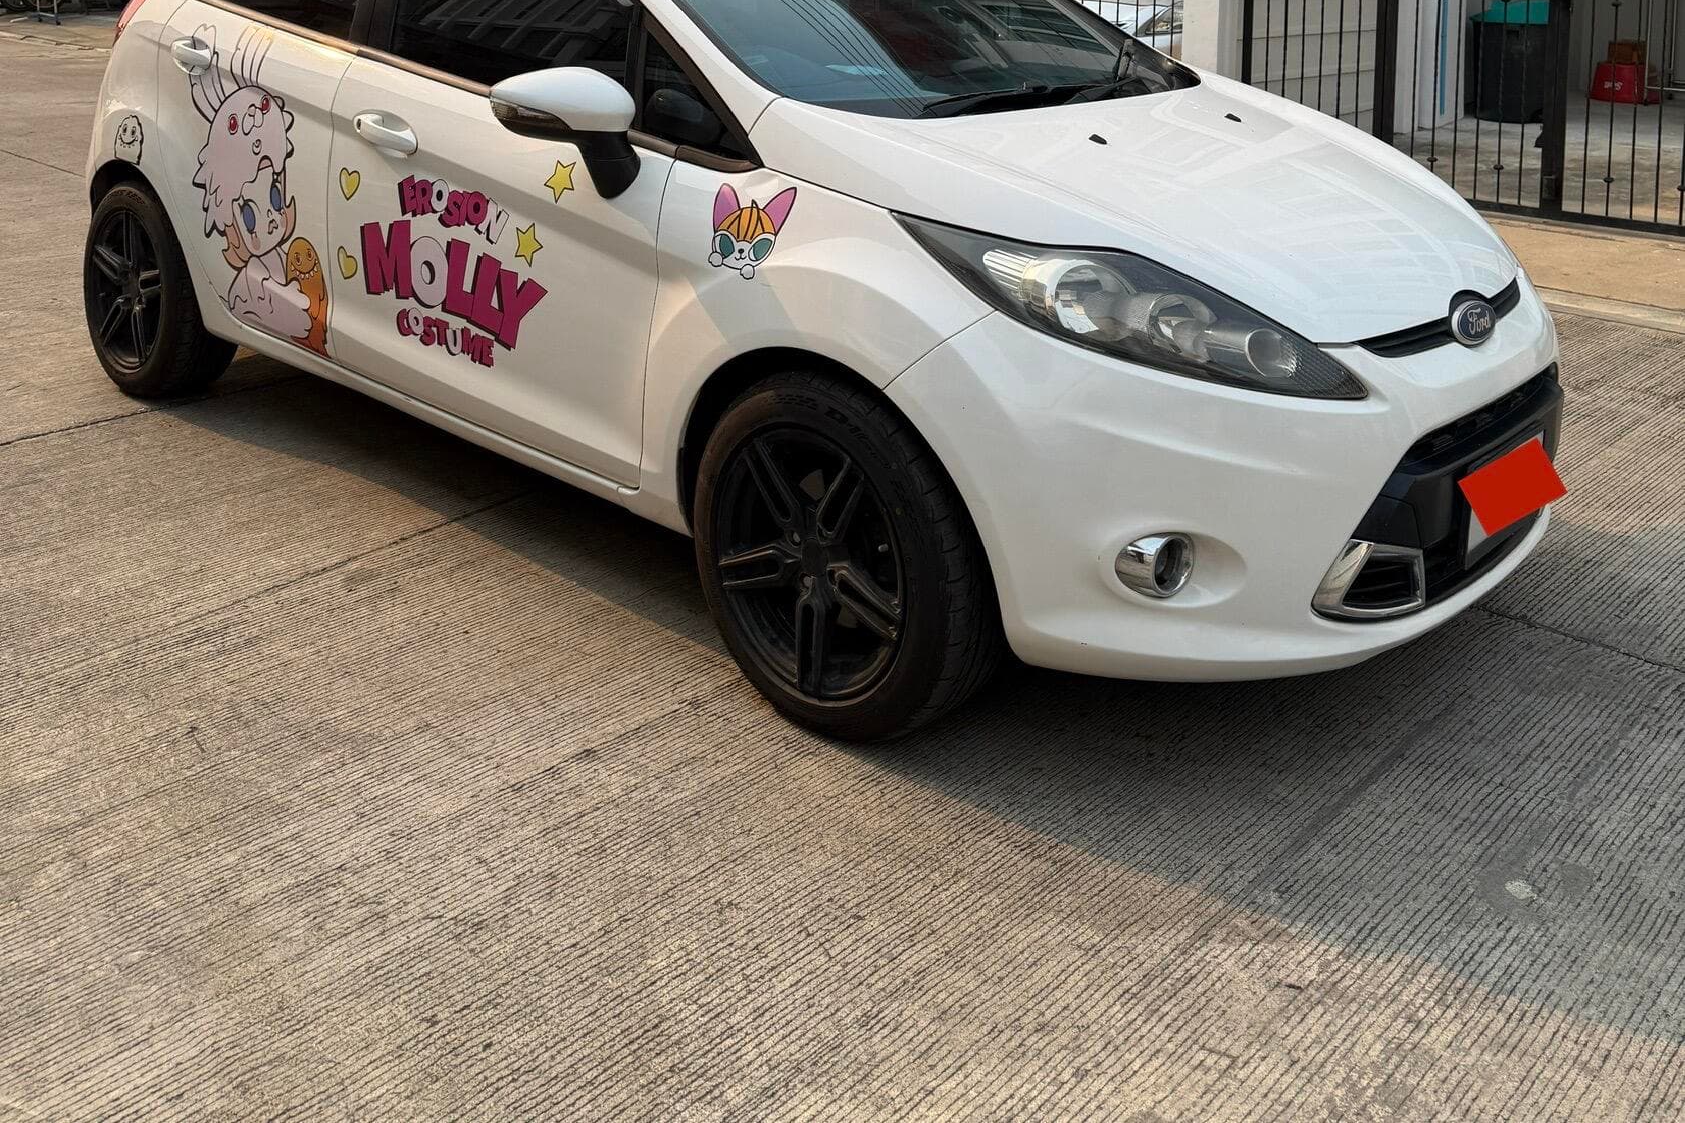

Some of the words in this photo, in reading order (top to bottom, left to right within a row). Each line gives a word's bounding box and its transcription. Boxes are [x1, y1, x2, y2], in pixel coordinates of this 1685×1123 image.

[397, 174, 511, 245] EROSION
[360, 219, 548, 351] MOLLY
[396, 307, 495, 368] COSTUME
[1467, 306, 1491, 335] Ford
